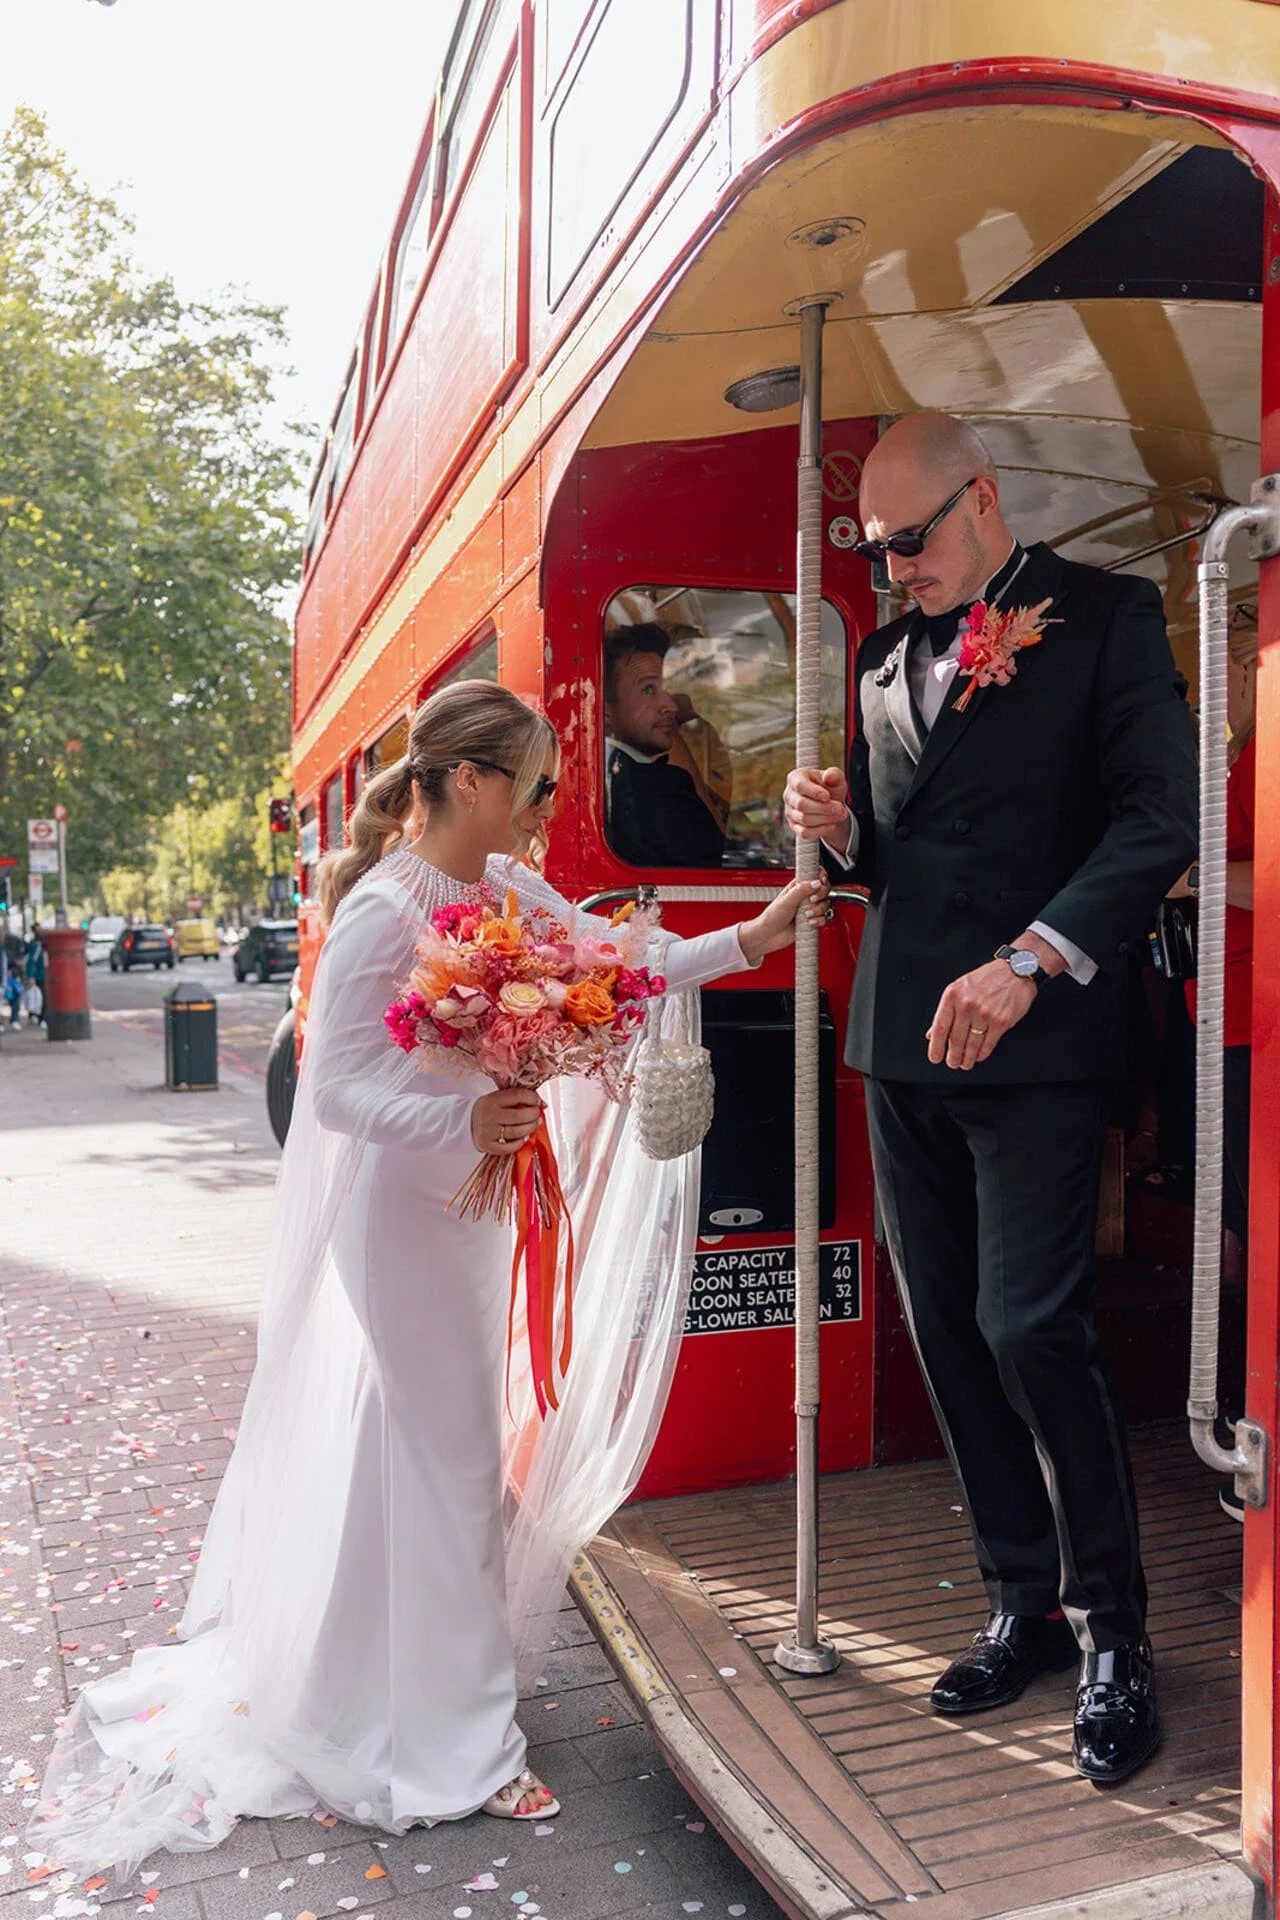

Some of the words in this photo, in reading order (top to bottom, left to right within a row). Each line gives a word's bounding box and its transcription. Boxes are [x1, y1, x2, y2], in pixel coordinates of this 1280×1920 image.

[704, 1251, 786, 1271] CAPACITY
[833, 1247, 851, 1262] 72
[832, 1265, 852, 1280] 40
[747, 1288, 796, 1306] SEATE
[835, 1284, 852, 1298] 32
[680, 1310, 758, 1331] G-LOWER
[763, 1303, 832, 1323] SALN
[843, 1302, 852, 1316] 5
